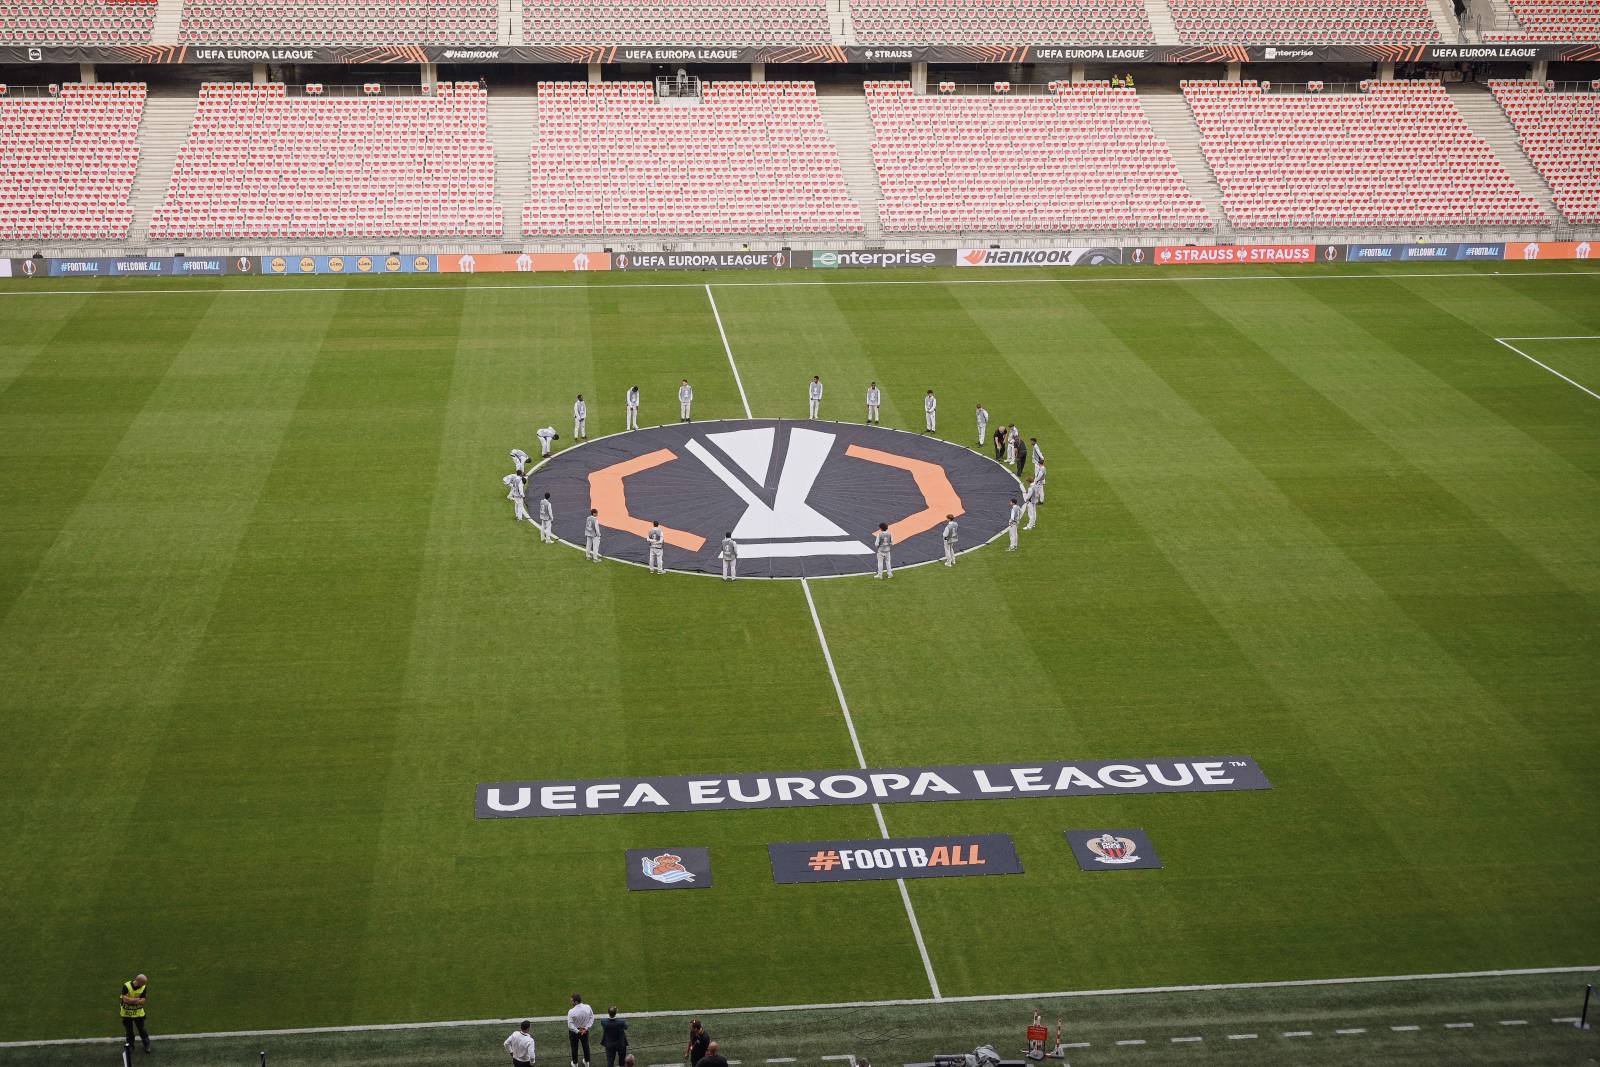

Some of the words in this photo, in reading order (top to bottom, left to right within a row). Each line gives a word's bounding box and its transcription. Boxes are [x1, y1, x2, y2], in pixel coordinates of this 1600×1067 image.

[196, 49, 225, 60] UEFA
[227, 49, 270, 60] EUROPA
[272, 49, 314, 60] LEAGUE
[625, 50, 653, 59] UEFA
[655, 50, 696, 59] EUROPA
[698, 50, 739, 59] LEAGUE
[874, 50, 912, 58] STRAUSS
[1036, 49, 1063, 59] UEFA
[1065, 49, 1104, 59] EUROPA
[1106, 49, 1145, 59] LEAGUE
[1432, 48, 1458, 58] UEFA
[1460, 48, 1497, 58] EUROPA
[1499, 48, 1536, 58] LEAGUE
[1174, 249, 1234, 261] STRAUSS
[1250, 248, 1310, 260] STRAUSS
[1359, 247, 1392, 257] #FOOTBALL
[1408, 247, 1435, 257] WELCOME
[1435, 247, 1448, 257] ALL
[1465, 246, 1499, 256] #FOOTBALL
[633, 255, 666, 267] UEFA
[669, 255, 718, 267] EUROPA
[721, 254, 768, 266] LEAGUE
[813, 250, 935, 268] enterprise
[61, 262, 99, 272] #FOOTBALL
[117, 262, 148, 272] WELCOME
[149, 262, 161, 271] ALL
[182, 260, 220, 271] #FOOTBALL
[486, 782, 670, 812] UEFA
[688, 773, 960, 804] EUROPA
[972, 762, 1235, 793] LEAGUE
[808, 844, 986, 871] #FOOTBALL
